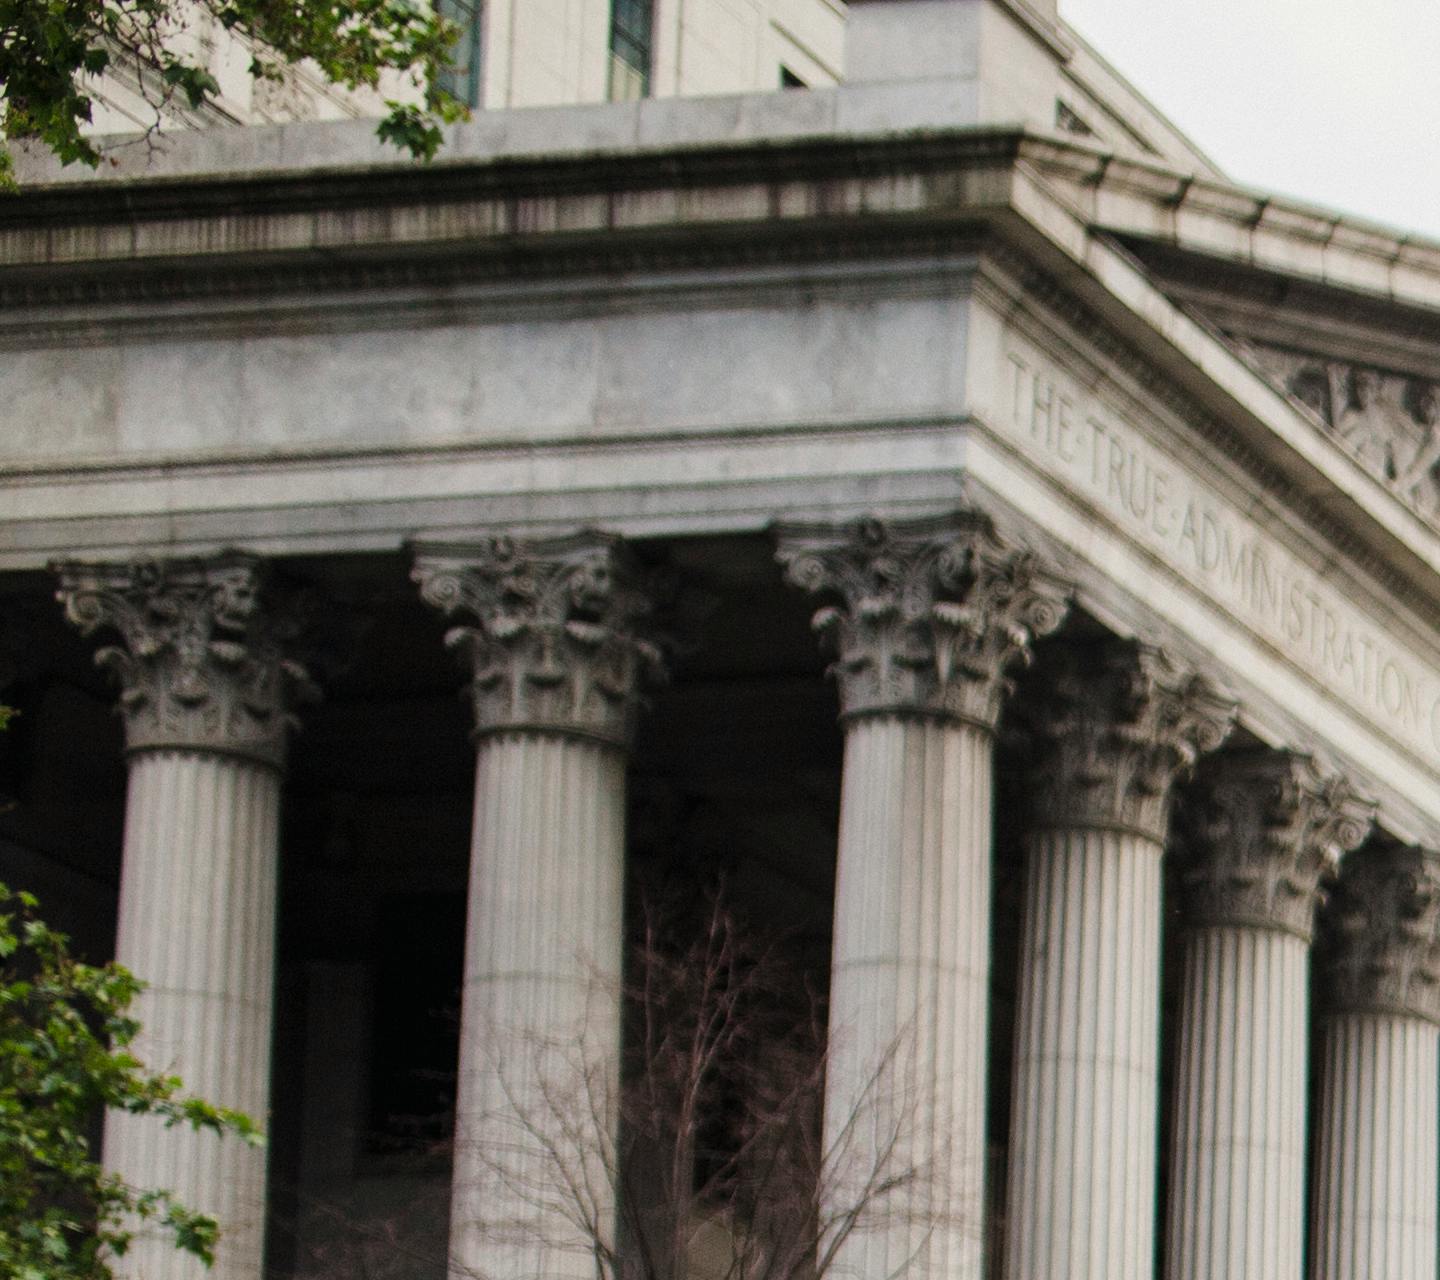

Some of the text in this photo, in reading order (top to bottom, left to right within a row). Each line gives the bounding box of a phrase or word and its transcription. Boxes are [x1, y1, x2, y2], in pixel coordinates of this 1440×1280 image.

[1006, 352, 1075, 463] THE
[1085, 414, 1170, 538] TRUE
[1178, 498, 1419, 731] ADMINISTRATION
